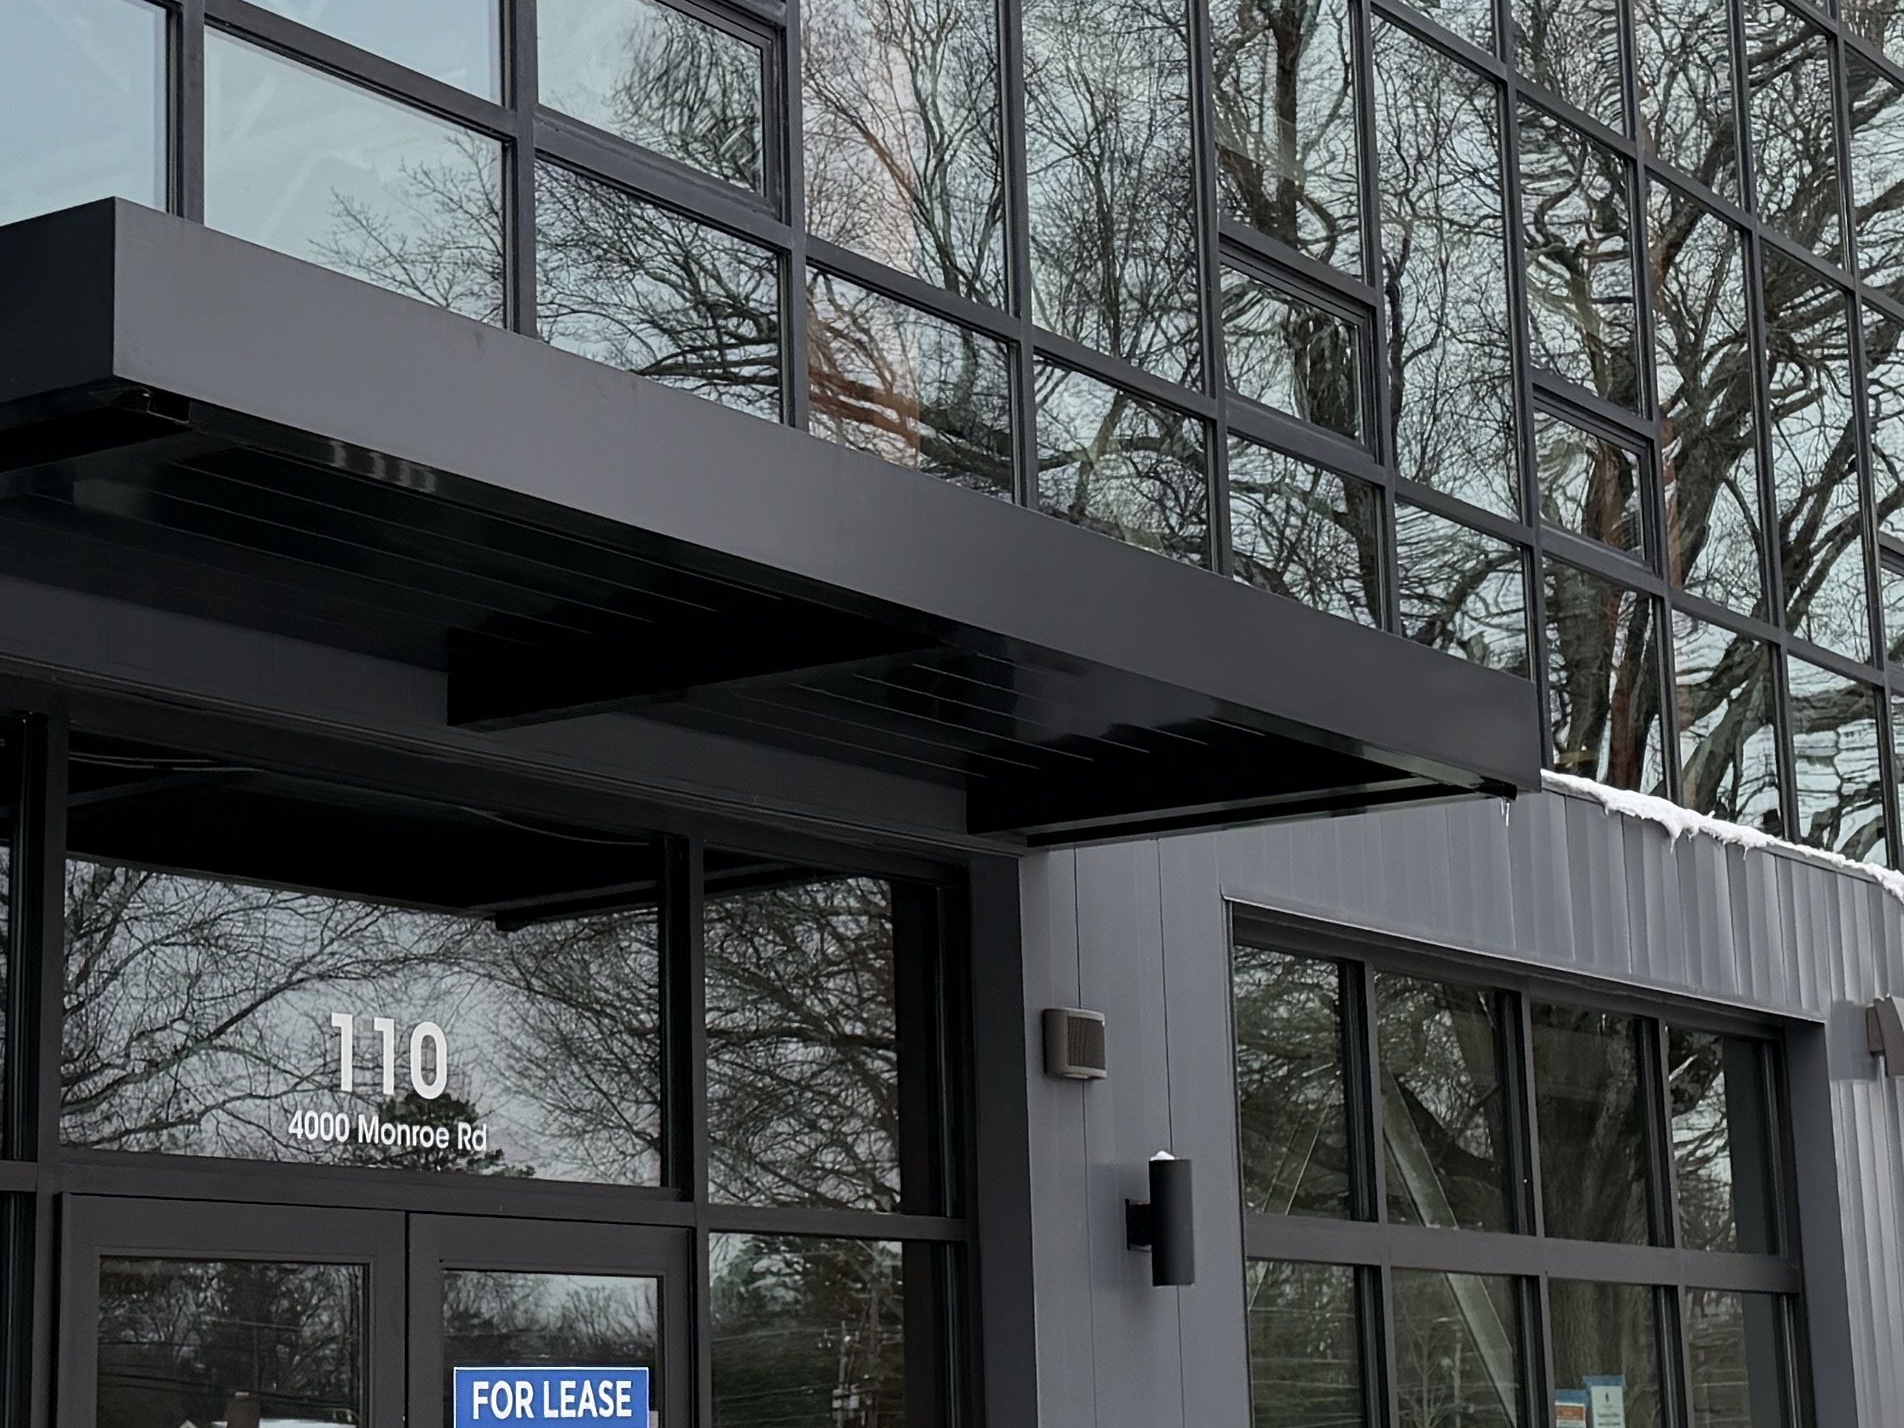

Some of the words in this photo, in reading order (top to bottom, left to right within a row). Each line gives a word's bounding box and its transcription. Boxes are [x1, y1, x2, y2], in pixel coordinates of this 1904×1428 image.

[331, 1012, 448, 1100] 110
[288, 1109, 351, 1143] 4000
[358, 1114, 450, 1149] Monroe
[457, 1121, 487, 1151] Rd
[472, 1380, 534, 1420] FOR
[543, 1380, 633, 1419] LEASE
